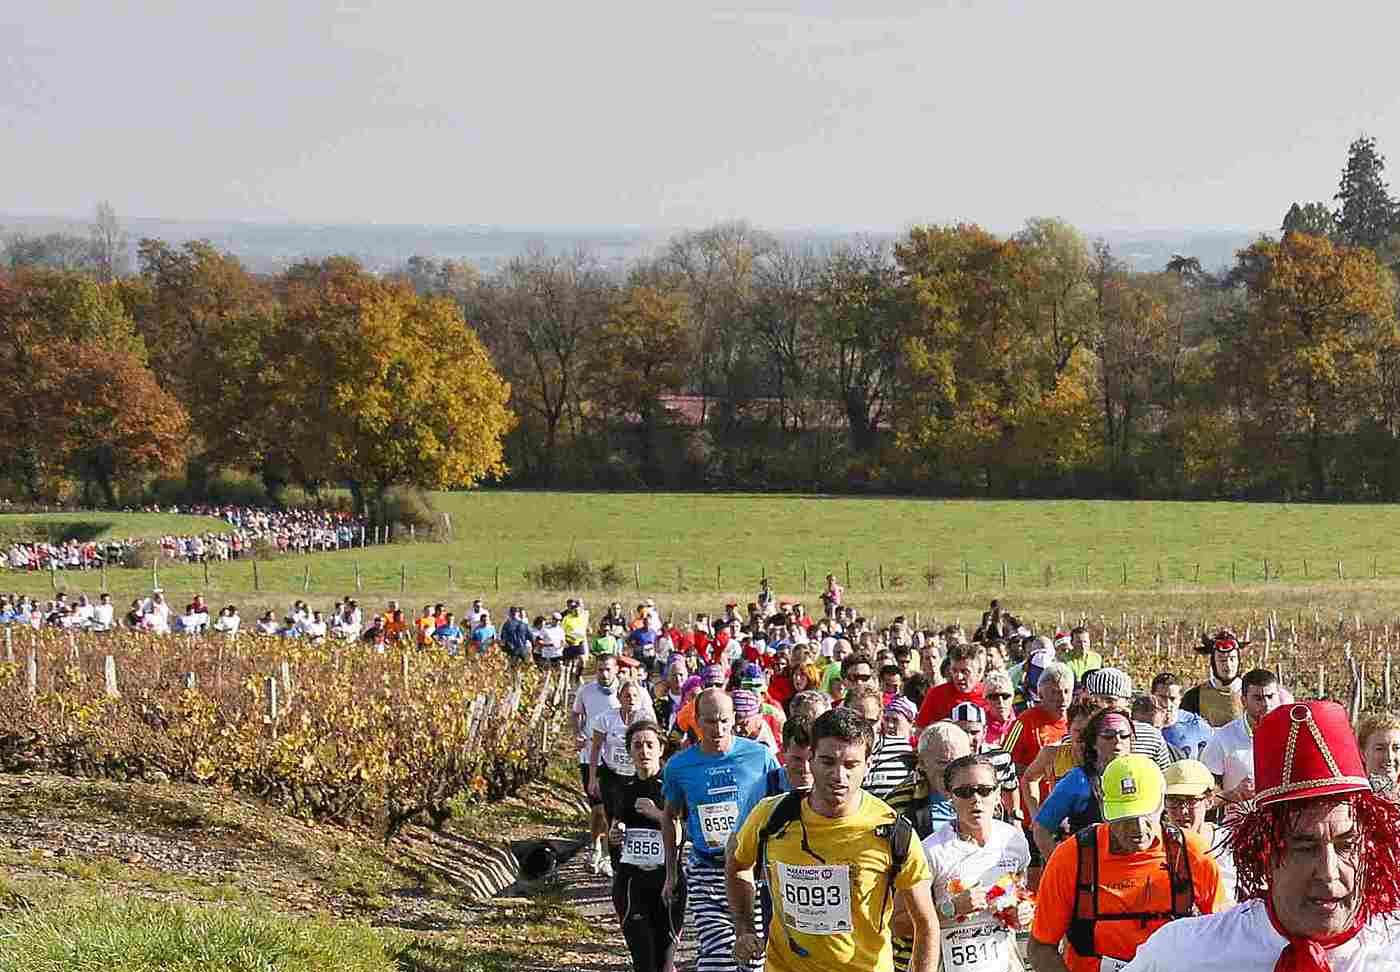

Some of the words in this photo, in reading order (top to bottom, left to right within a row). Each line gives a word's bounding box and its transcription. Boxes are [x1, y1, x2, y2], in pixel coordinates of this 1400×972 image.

[627, 841, 660, 855] 5856
[785, 883, 841, 906] 6093
[952, 941, 999, 966] 5811
